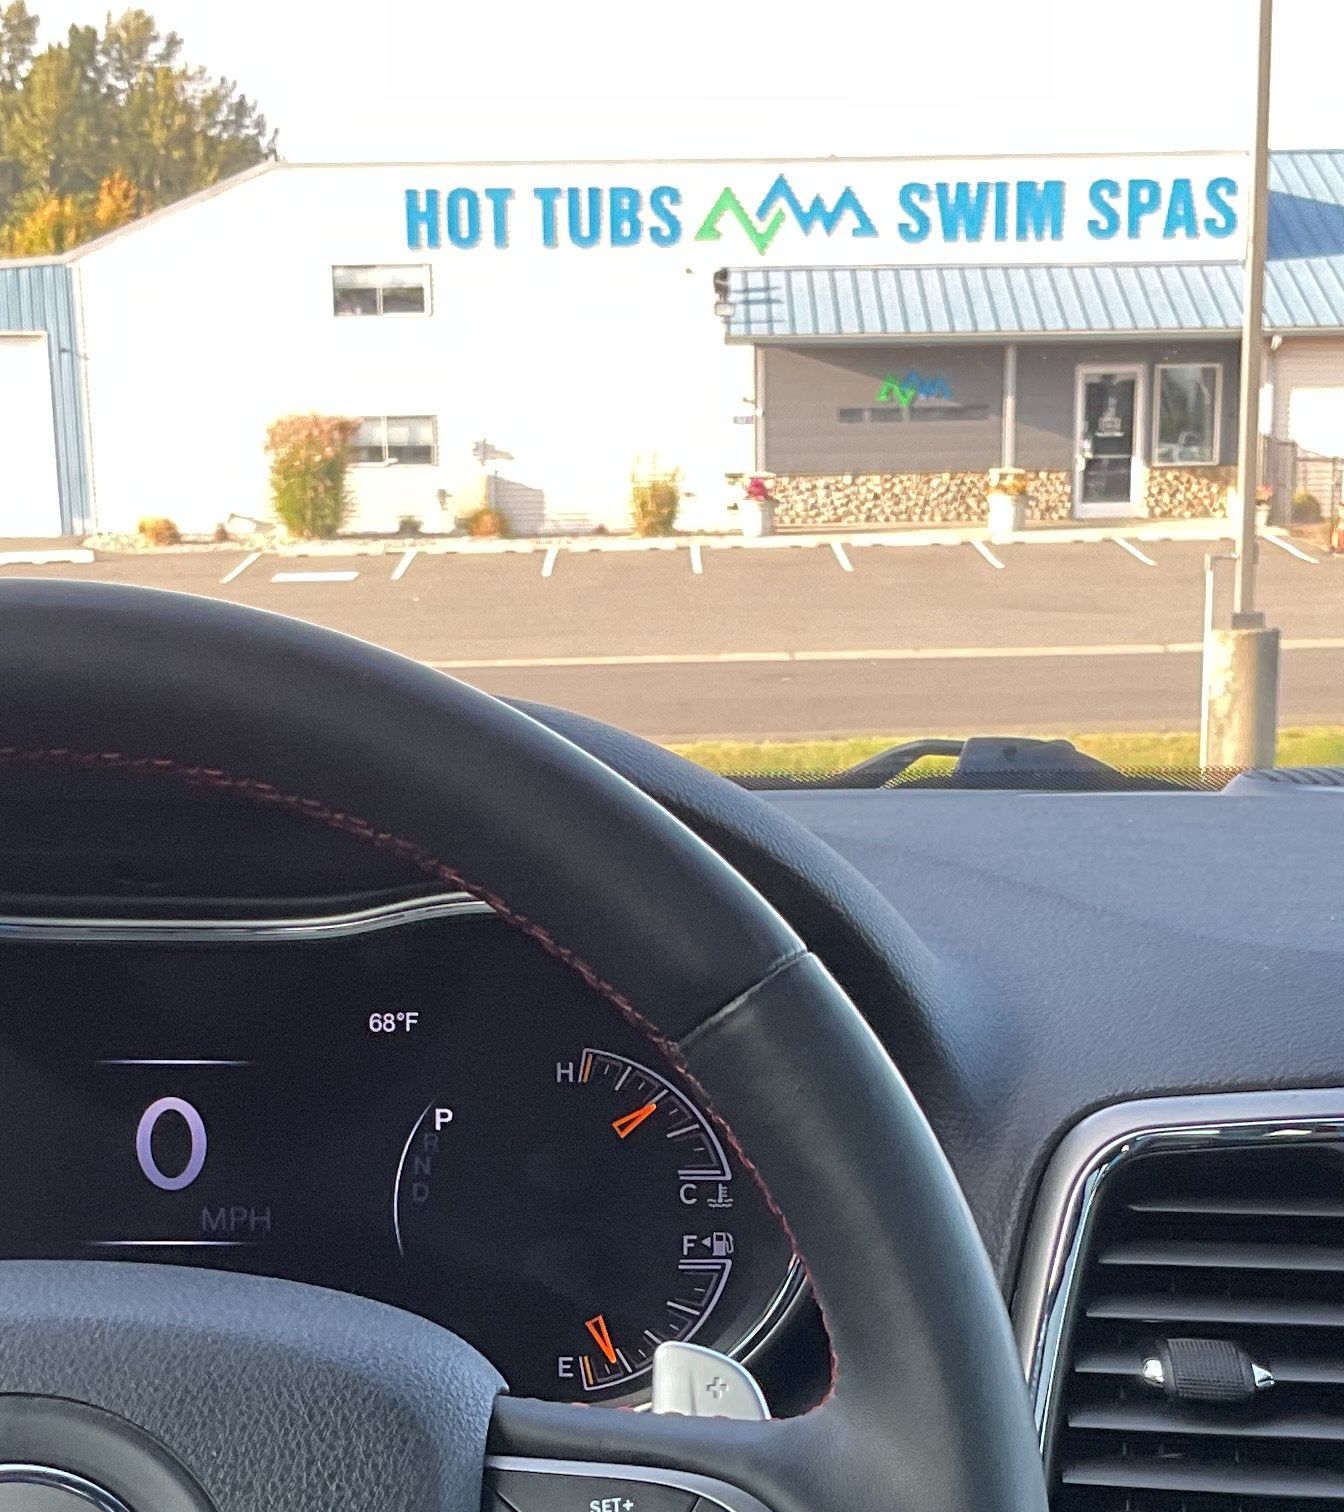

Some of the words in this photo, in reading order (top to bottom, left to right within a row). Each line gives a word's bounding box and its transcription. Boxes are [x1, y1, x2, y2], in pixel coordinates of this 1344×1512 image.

[405, 187, 514, 250] HOT
[534, 185, 683, 249] TUBS
[898, 180, 1066, 244] SWIM
[1087, 176, 1239, 241] SPAS
[368, 1012, 419, 1033] 68°F
[556, 1062, 574, 1083] H
[434, 1107, 454, 1131] P
[136, 1096, 207, 1191] 0
[423, 1132, 440, 1152] R
[413, 1155, 432, 1176] N
[411, 1182, 430, 1202] D
[679, 1183, 697, 1205] C
[201, 1206, 272, 1232] MPH
[682, 1234, 698, 1256] F
[558, 1356, 574, 1378] E
